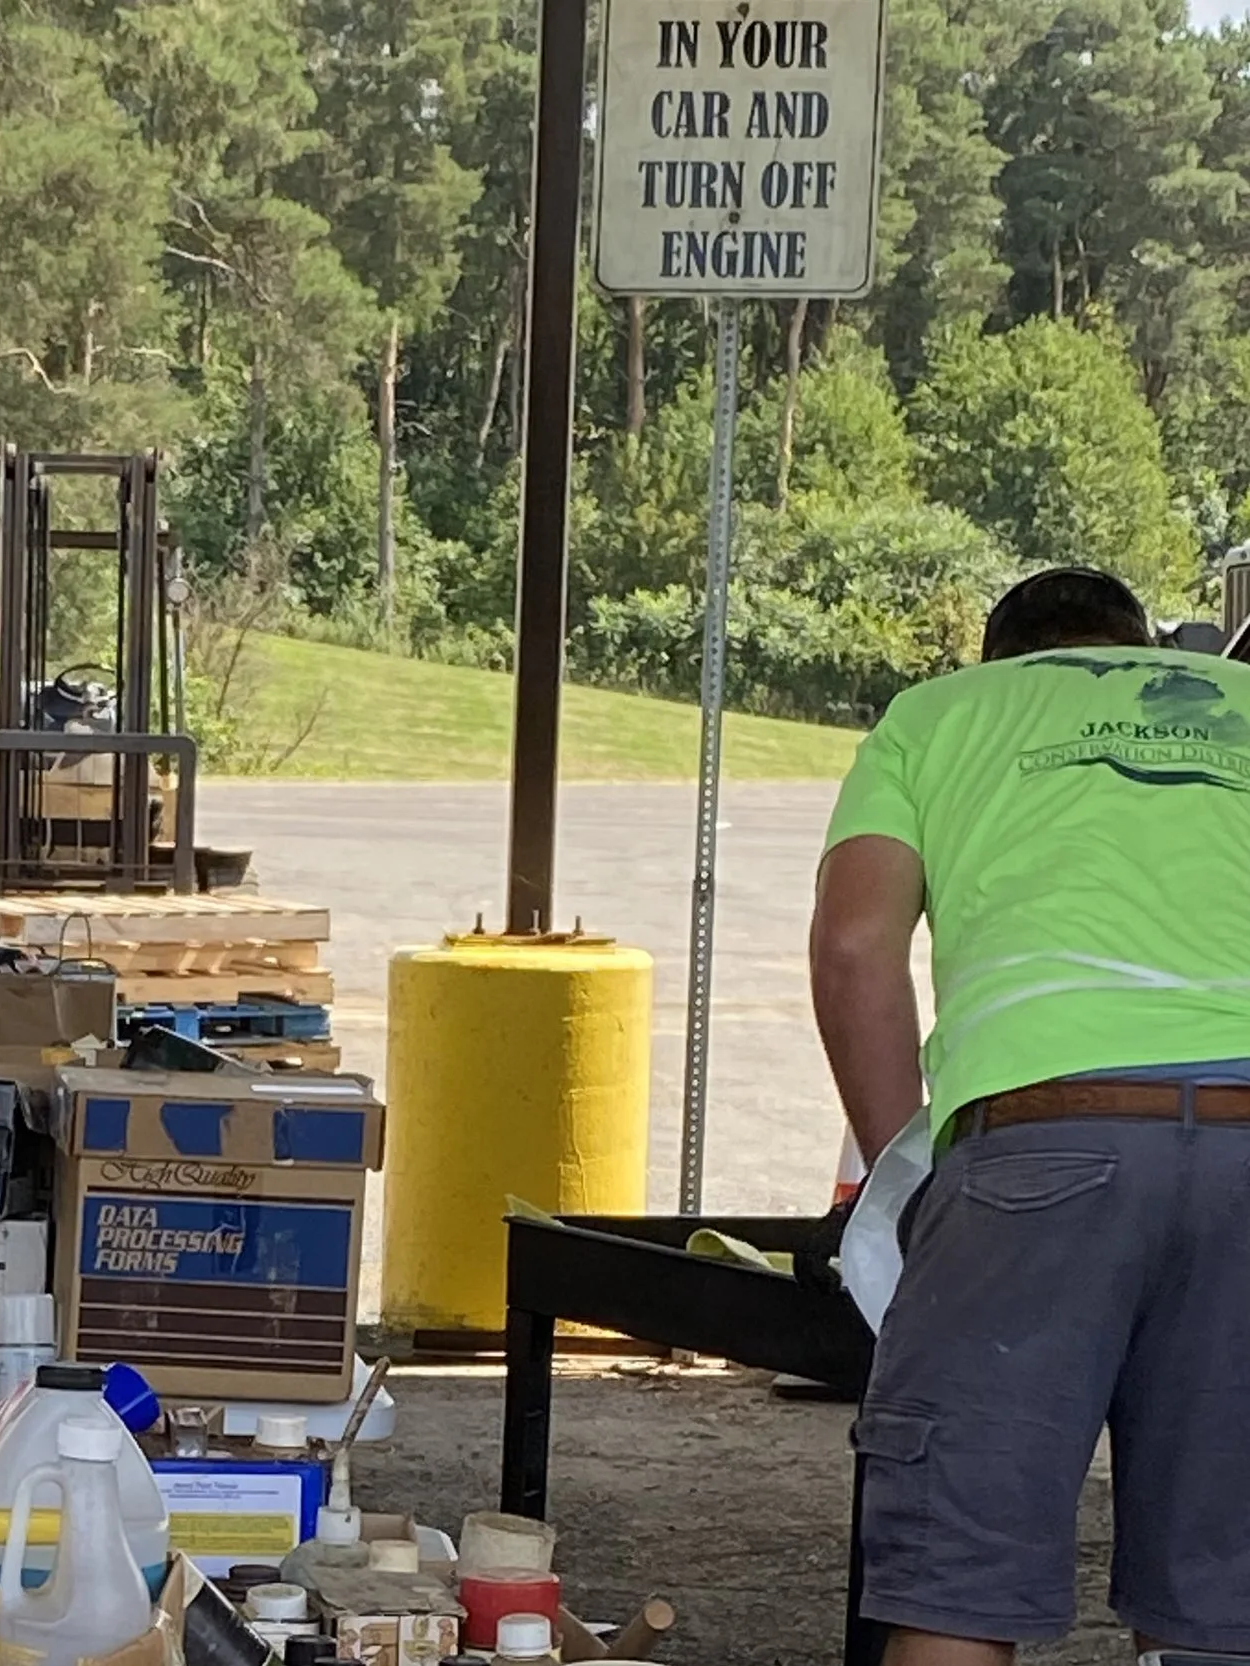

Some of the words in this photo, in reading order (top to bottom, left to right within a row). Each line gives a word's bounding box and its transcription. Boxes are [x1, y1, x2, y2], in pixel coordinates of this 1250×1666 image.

[656, 20, 700, 68] IN
[716, 20, 828, 68] YOUR
[651, 90, 731, 139] CAR
[745, 91, 829, 139] AND
[638, 160, 746, 209] TURN
[761, 160, 837, 209] OFF
[659, 230, 807, 279] ENGINE
[1080, 721, 1210, 741] JACKSON
[100, 1160, 172, 1190] High
[174, 1161, 256, 1191] Quality
[97, 1205, 158, 1228] DATA
[96, 1228, 245, 1254] PROCESSING
[94, 1249, 179, 1273] FORMS
